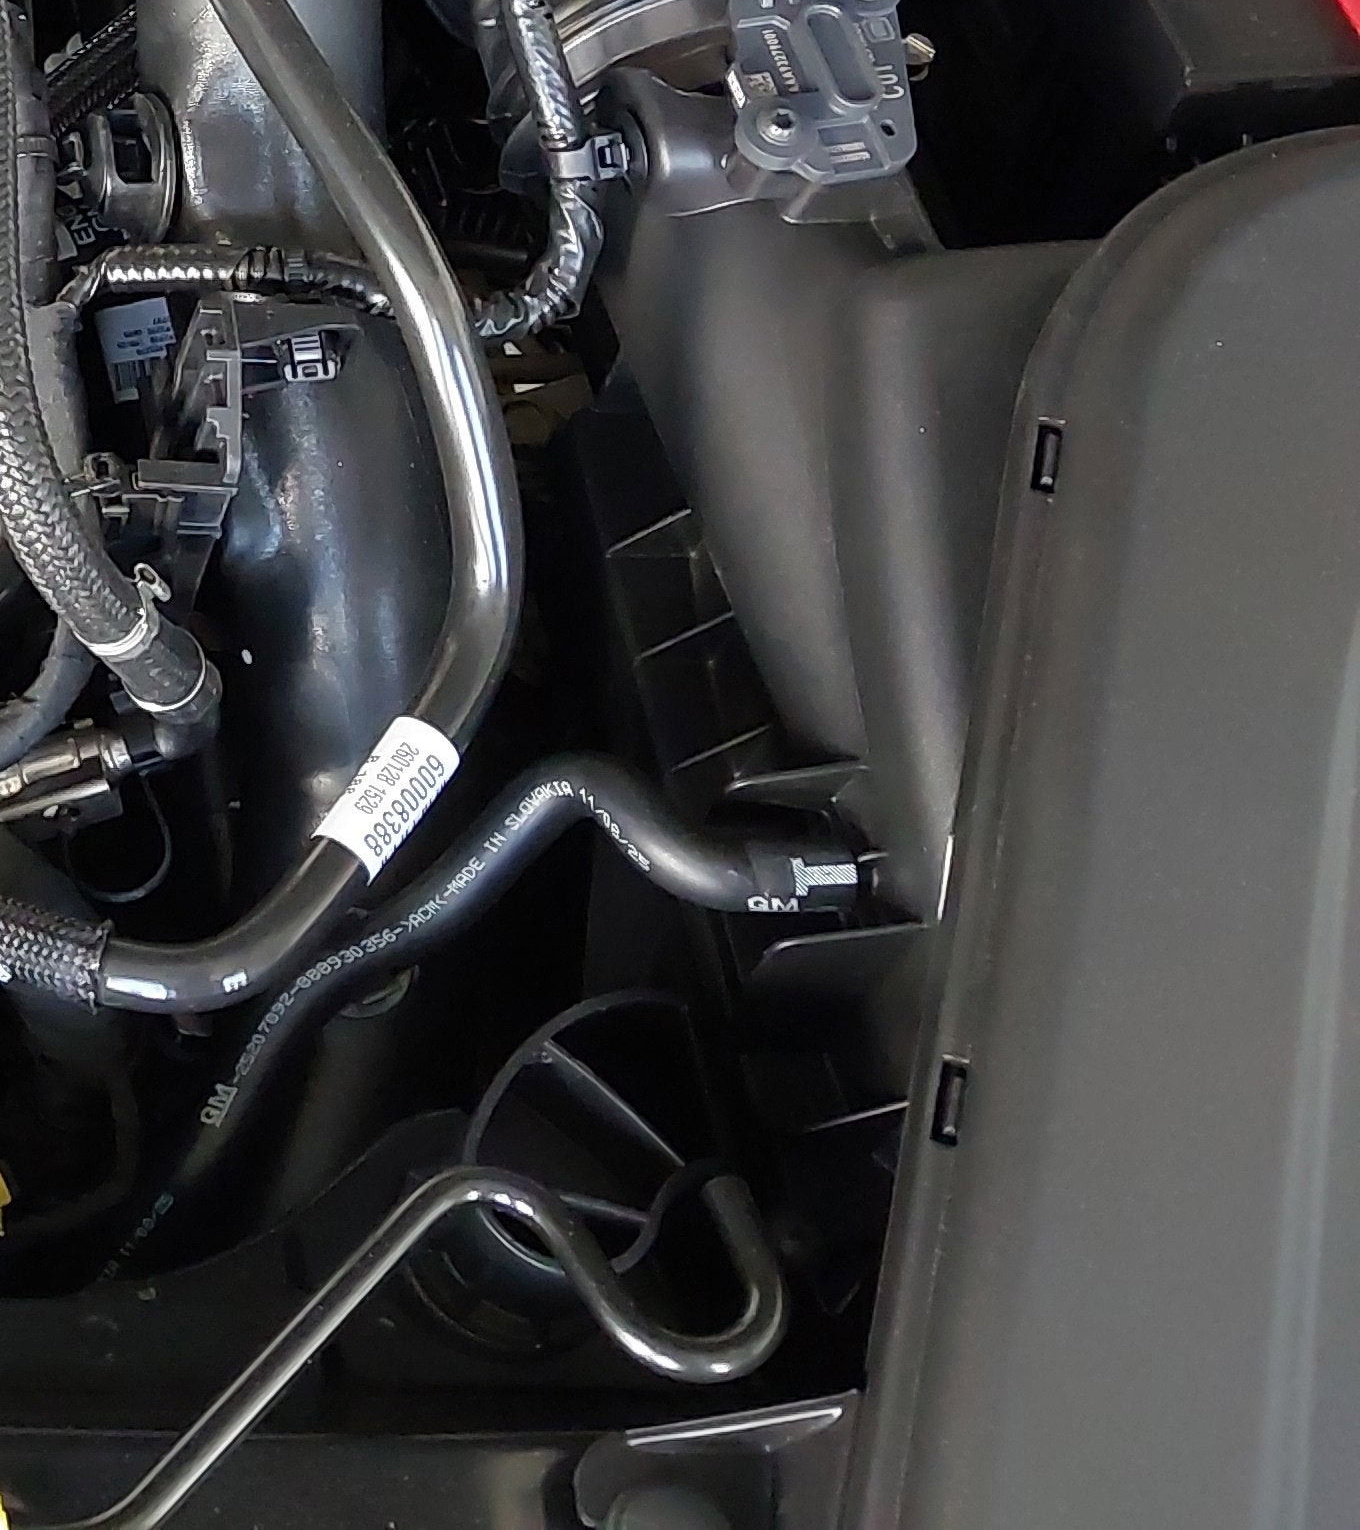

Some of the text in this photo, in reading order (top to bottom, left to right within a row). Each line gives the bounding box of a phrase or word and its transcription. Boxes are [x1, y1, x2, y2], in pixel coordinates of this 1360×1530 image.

[364, 754, 445, 857] 60008388
[483, 832, 508, 854] IN
[504, 780, 575, 831] SLOVAKIA
